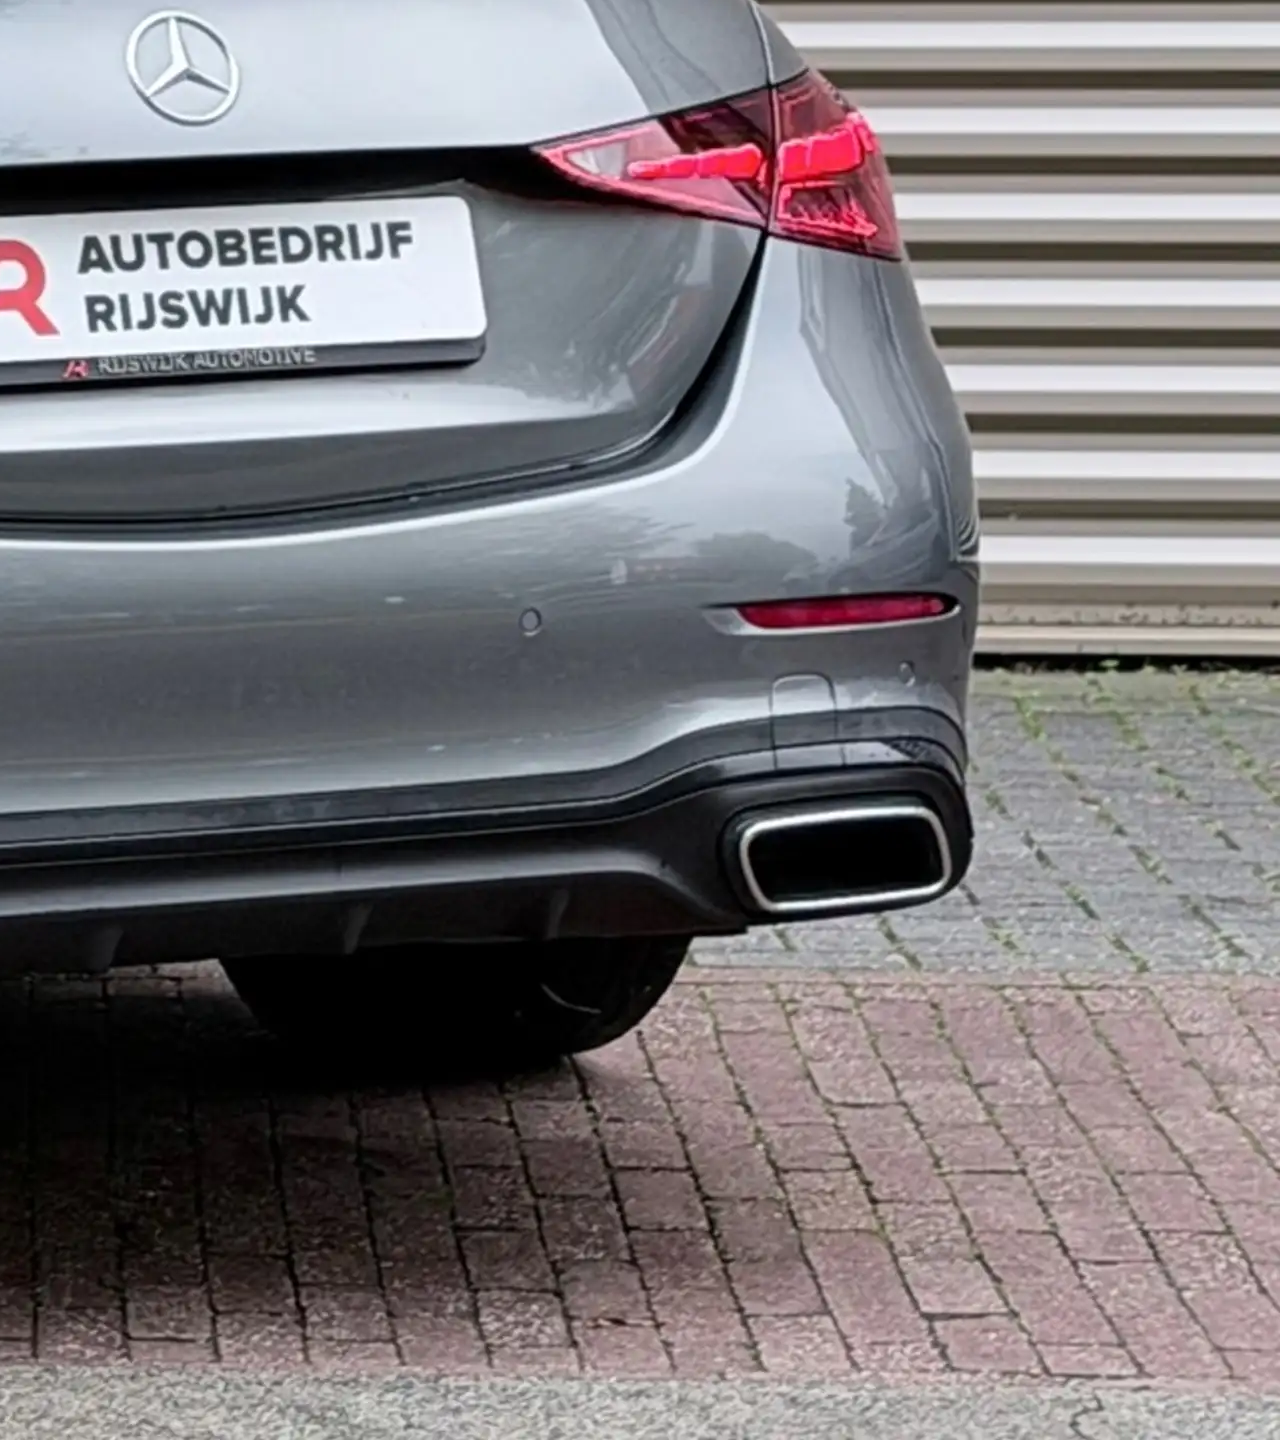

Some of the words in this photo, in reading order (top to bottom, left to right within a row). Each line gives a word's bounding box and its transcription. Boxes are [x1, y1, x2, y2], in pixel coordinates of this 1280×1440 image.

[76, 220, 414, 275] AUTOBEDRIJF
[83, 284, 311, 333] RIJSWIJK
[192, 346, 317, 368] AUTOMOTIVE
